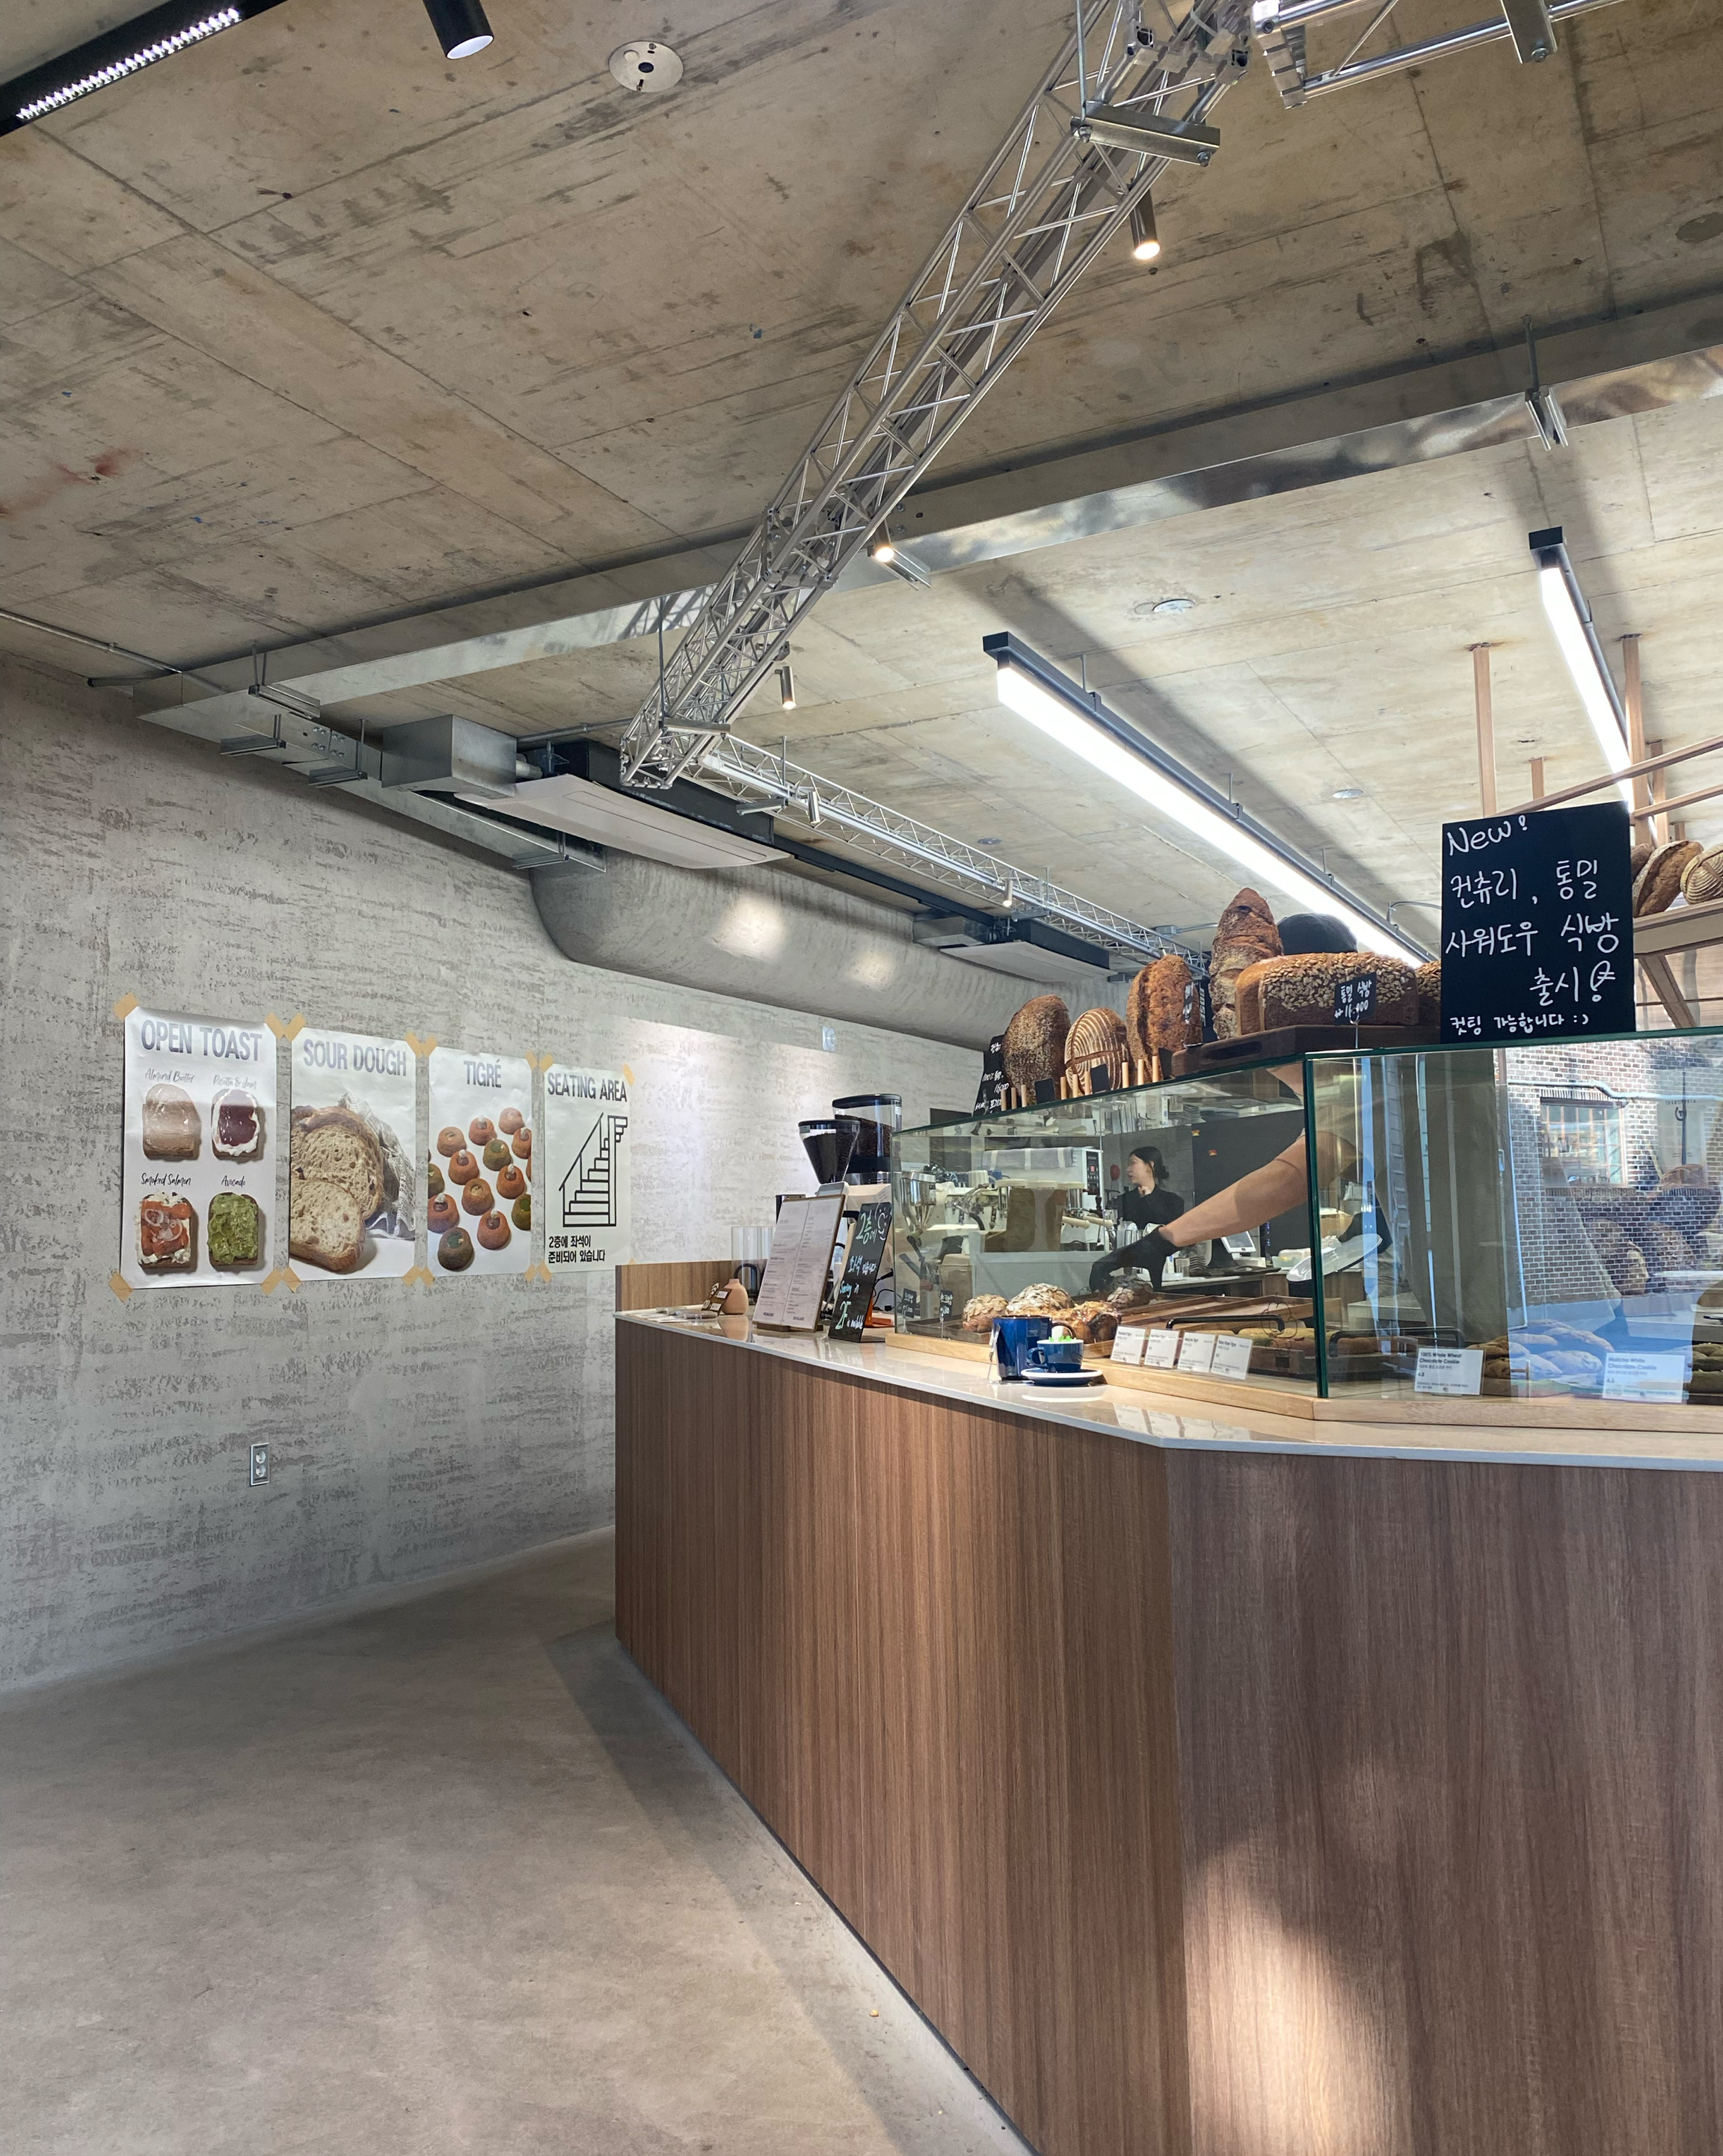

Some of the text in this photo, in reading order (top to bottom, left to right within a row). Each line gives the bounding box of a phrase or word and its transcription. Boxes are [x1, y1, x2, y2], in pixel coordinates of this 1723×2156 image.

[1556, 859, 1598, 900] 통밀
[1445, 912, 1620, 957] 사워도우 식빵
[1340, 979, 1372, 1004] 통밀 식빵
[1493, 1012, 1564, 1034] 가능합니다
[141, 1019, 262, 1061] OPEN TOAST
[303, 1039, 407, 1077] SOUR DOUGH
[144, 1067, 171, 1082] Almond
[464, 1058, 502, 1088] TIGRÉ
[547, 1072, 627, 1102] SEATING AREA
[141, 1172, 191, 1187] Smoked Salmon
[221, 1175, 246, 1188] Avocado
[548, 1235, 592, 1248] 2층에 좌석이
[548, 1249, 606, 1264] 준비되어 있습니다
